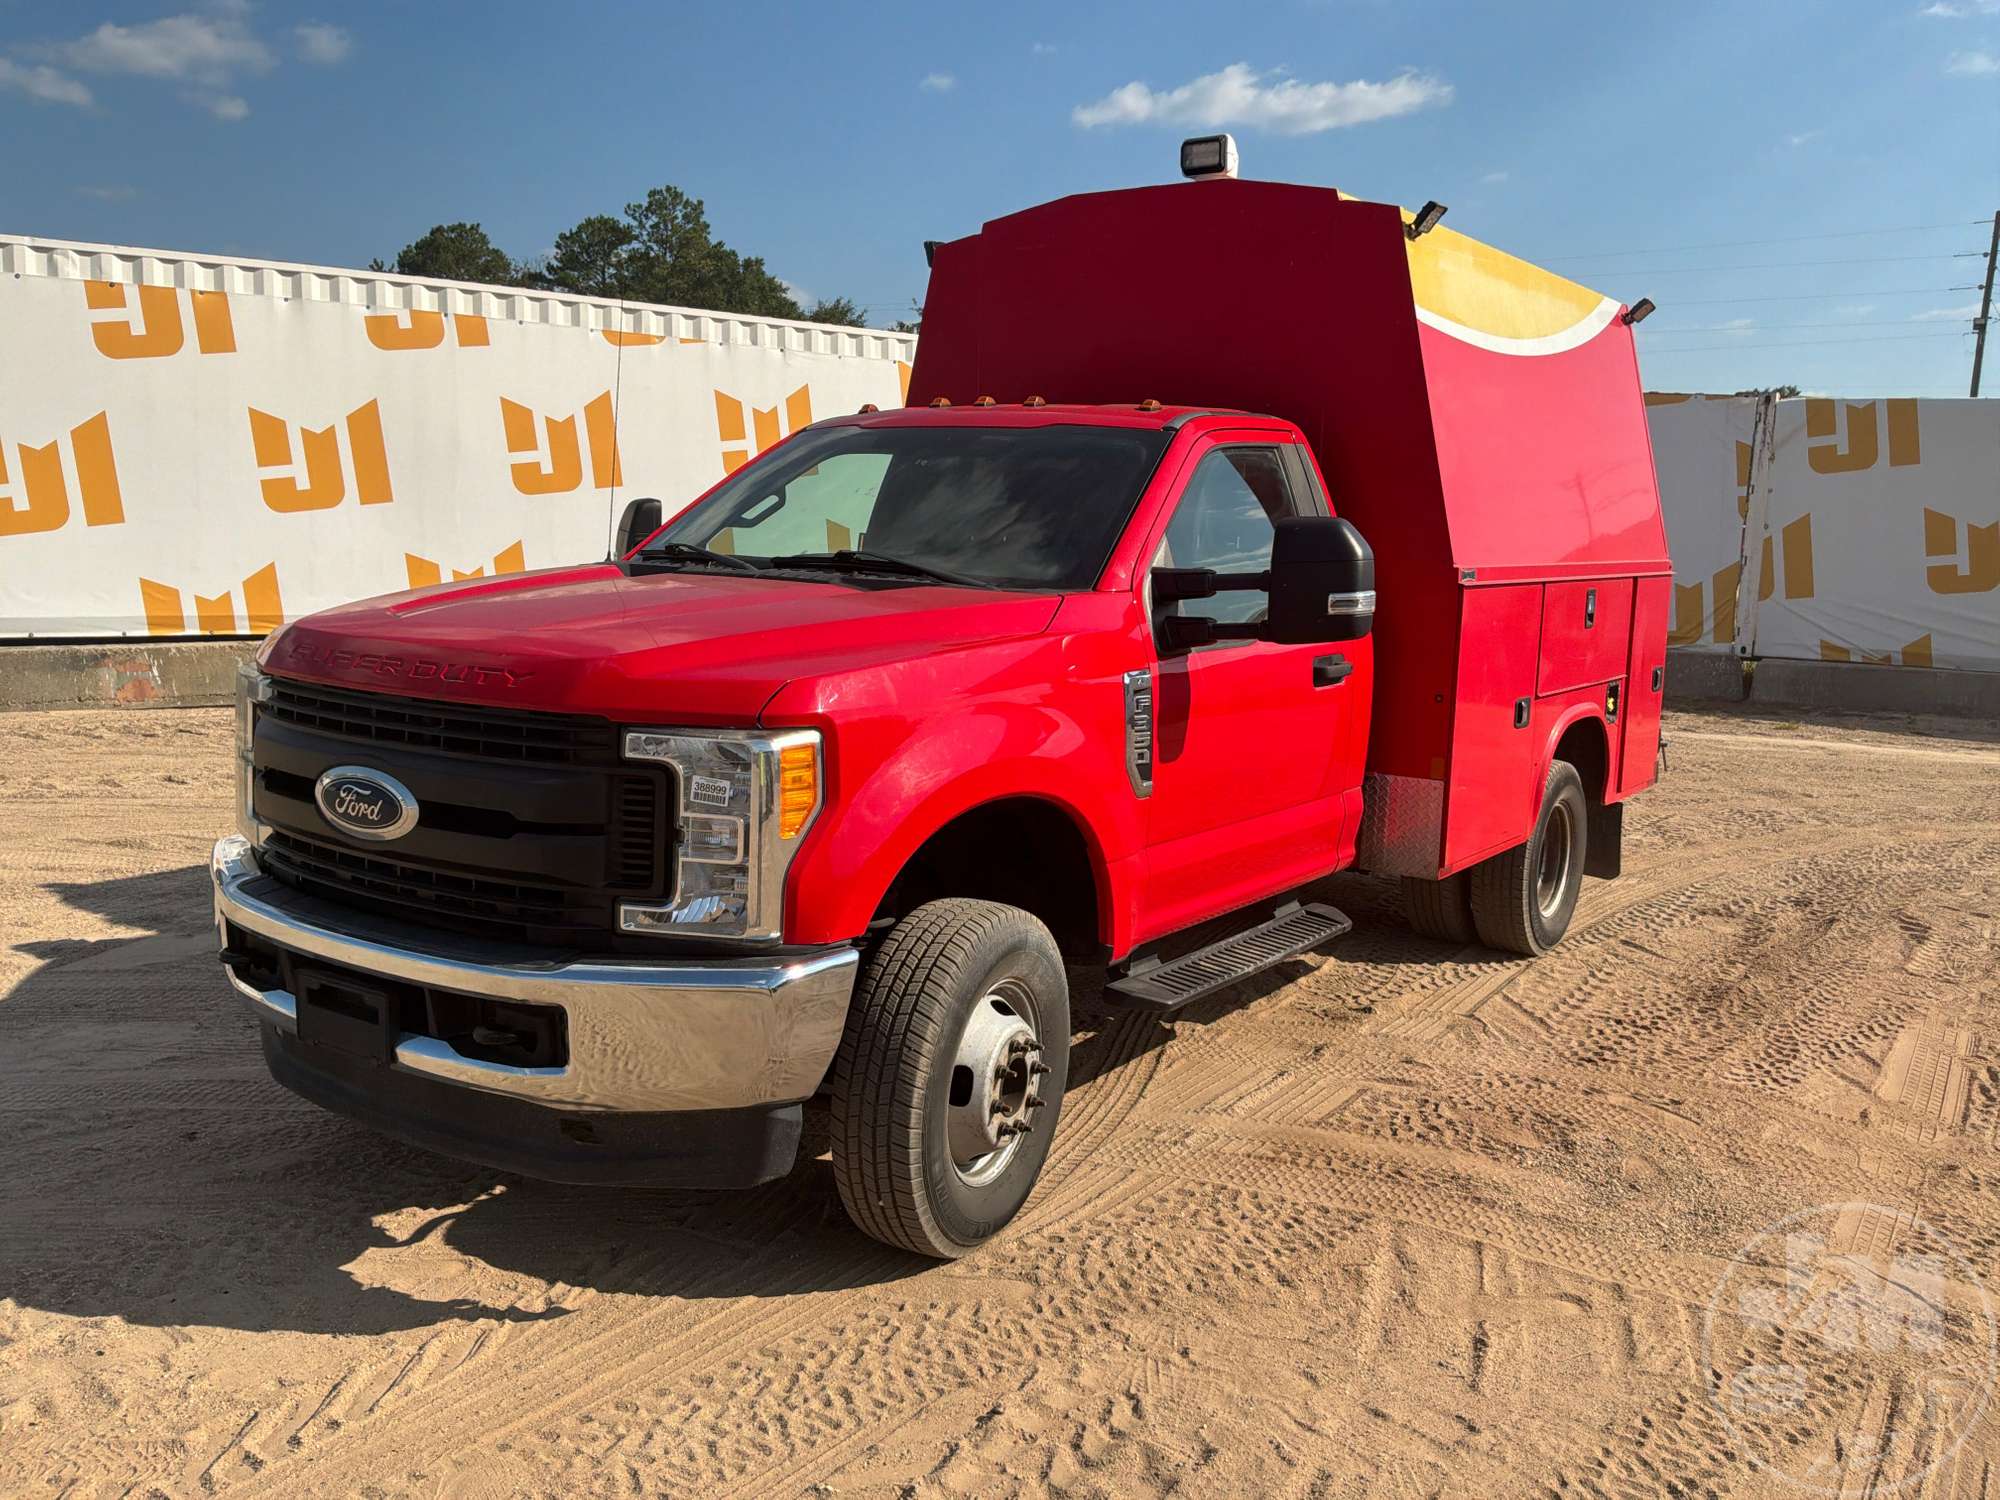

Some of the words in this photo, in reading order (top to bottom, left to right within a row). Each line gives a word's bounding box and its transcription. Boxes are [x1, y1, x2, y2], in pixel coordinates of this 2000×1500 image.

[409, 661, 540, 688] DUTY
[335, 784, 383, 820] Ford
[694, 781, 727, 796] 388999
